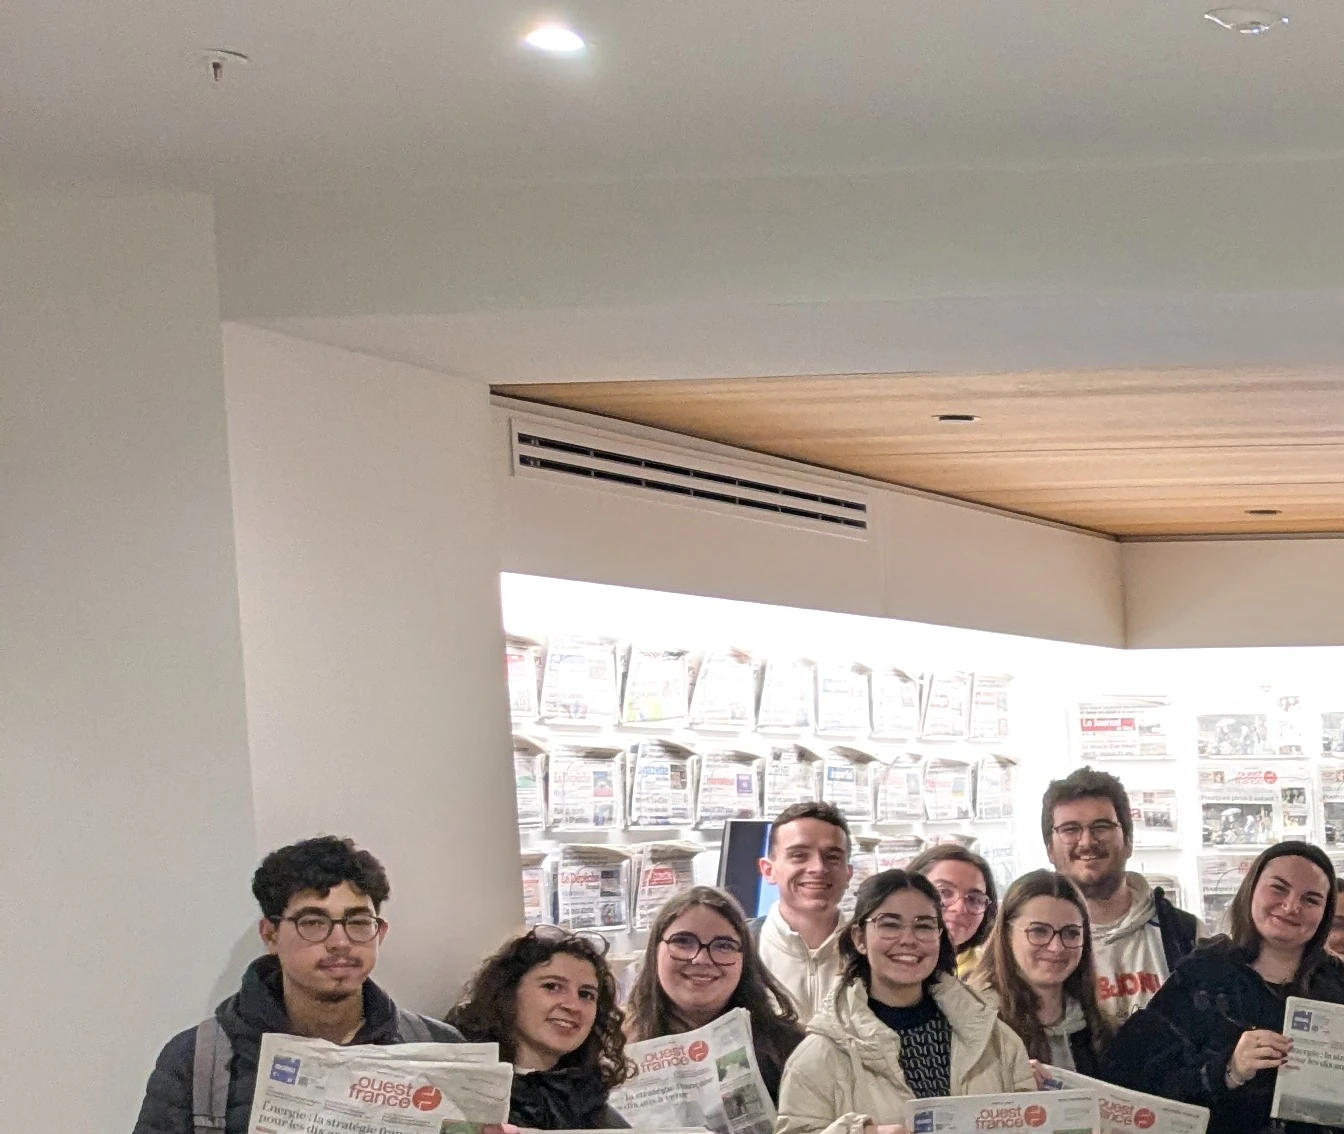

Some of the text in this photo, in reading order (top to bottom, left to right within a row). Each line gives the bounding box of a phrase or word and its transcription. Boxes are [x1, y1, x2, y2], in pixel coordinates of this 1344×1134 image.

[645, 1045, 687, 1061] ouest
[640, 1056, 689, 1073] france
[358, 1076, 412, 1097] ouest
[348, 1083, 411, 1108] france
[980, 1105, 1022, 1118] ouest
[975, 1116, 1024, 1130] france
